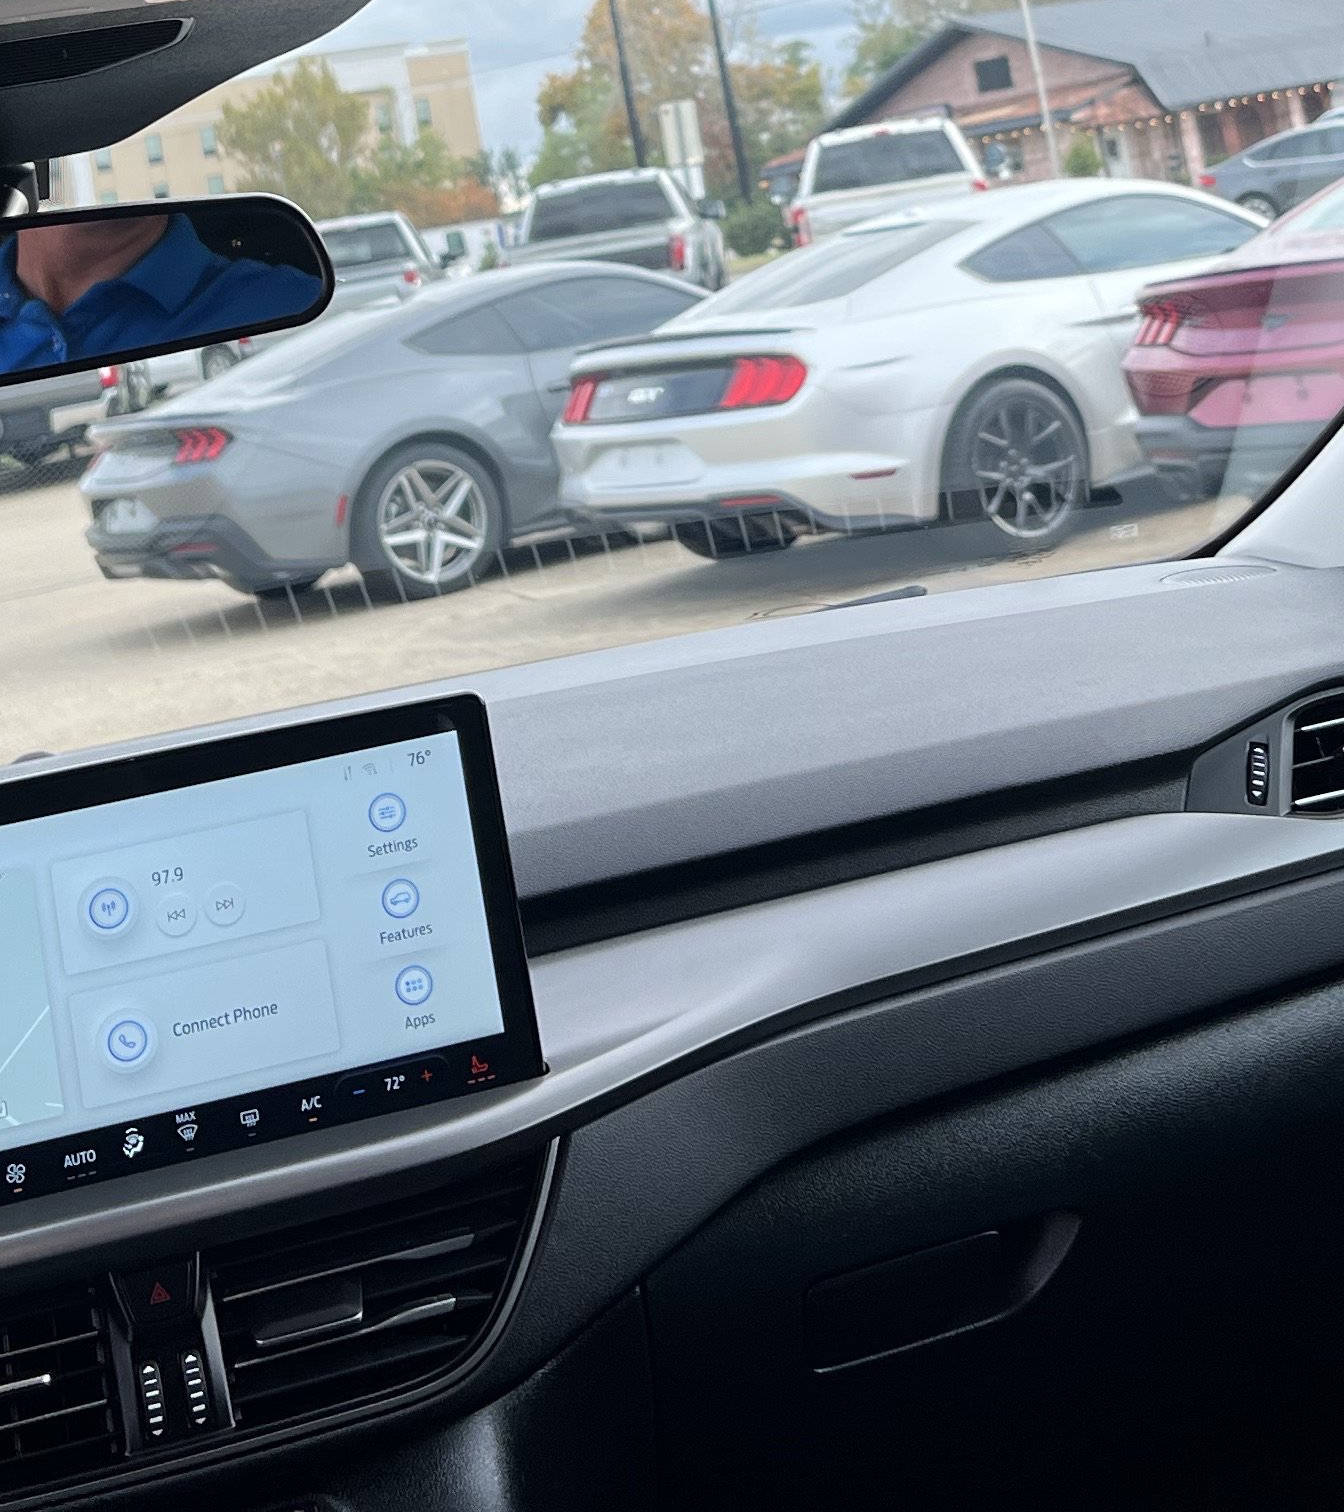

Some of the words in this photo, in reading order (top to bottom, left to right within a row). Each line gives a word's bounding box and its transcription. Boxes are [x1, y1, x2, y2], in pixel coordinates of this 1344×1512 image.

[367, 837, 419, 858] Settings
[151, 866, 184, 887] 97.9
[379, 923, 433, 945] Features
[172, 1011, 231, 1037] Connect
[232, 1002, 278, 1023] Phone
[404, 1013, 436, 1031] Apps
[300, 1095, 323, 1112] A/C
[175, 1110, 197, 1124] MAX
[63, 1149, 98, 1169] AUTO
